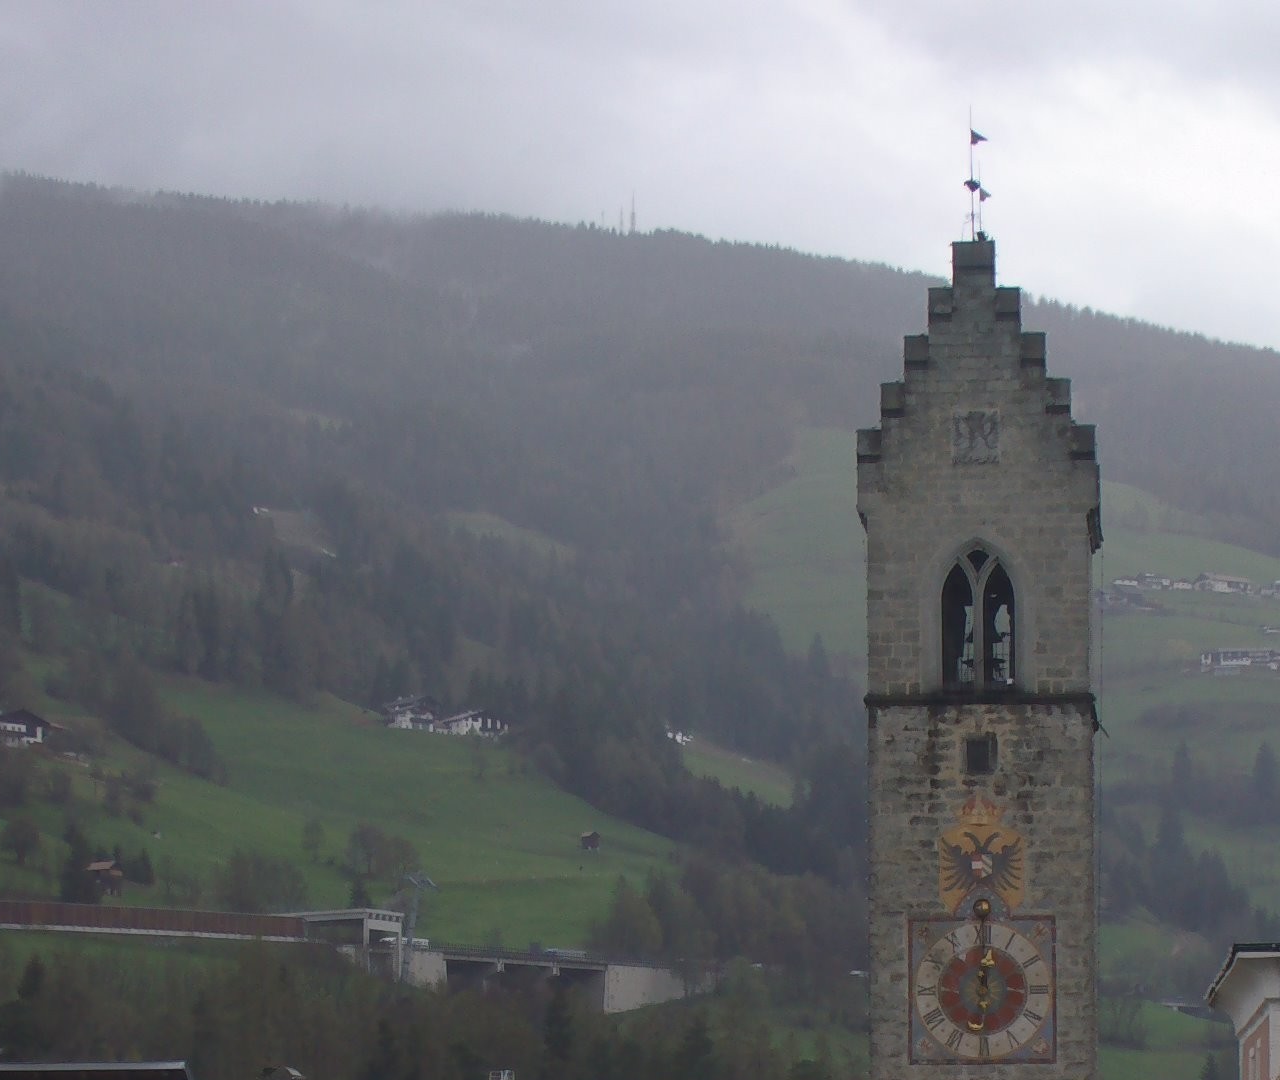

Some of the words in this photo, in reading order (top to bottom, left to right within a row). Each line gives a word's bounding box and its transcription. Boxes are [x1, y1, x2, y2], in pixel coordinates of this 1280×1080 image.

[1005, 932, 1016, 950] I
[1022, 954, 1041, 968] II
[917, 984, 936, 996] IX
[1029, 985, 1048, 995] III
[1006, 1029, 1020, 1050] V
